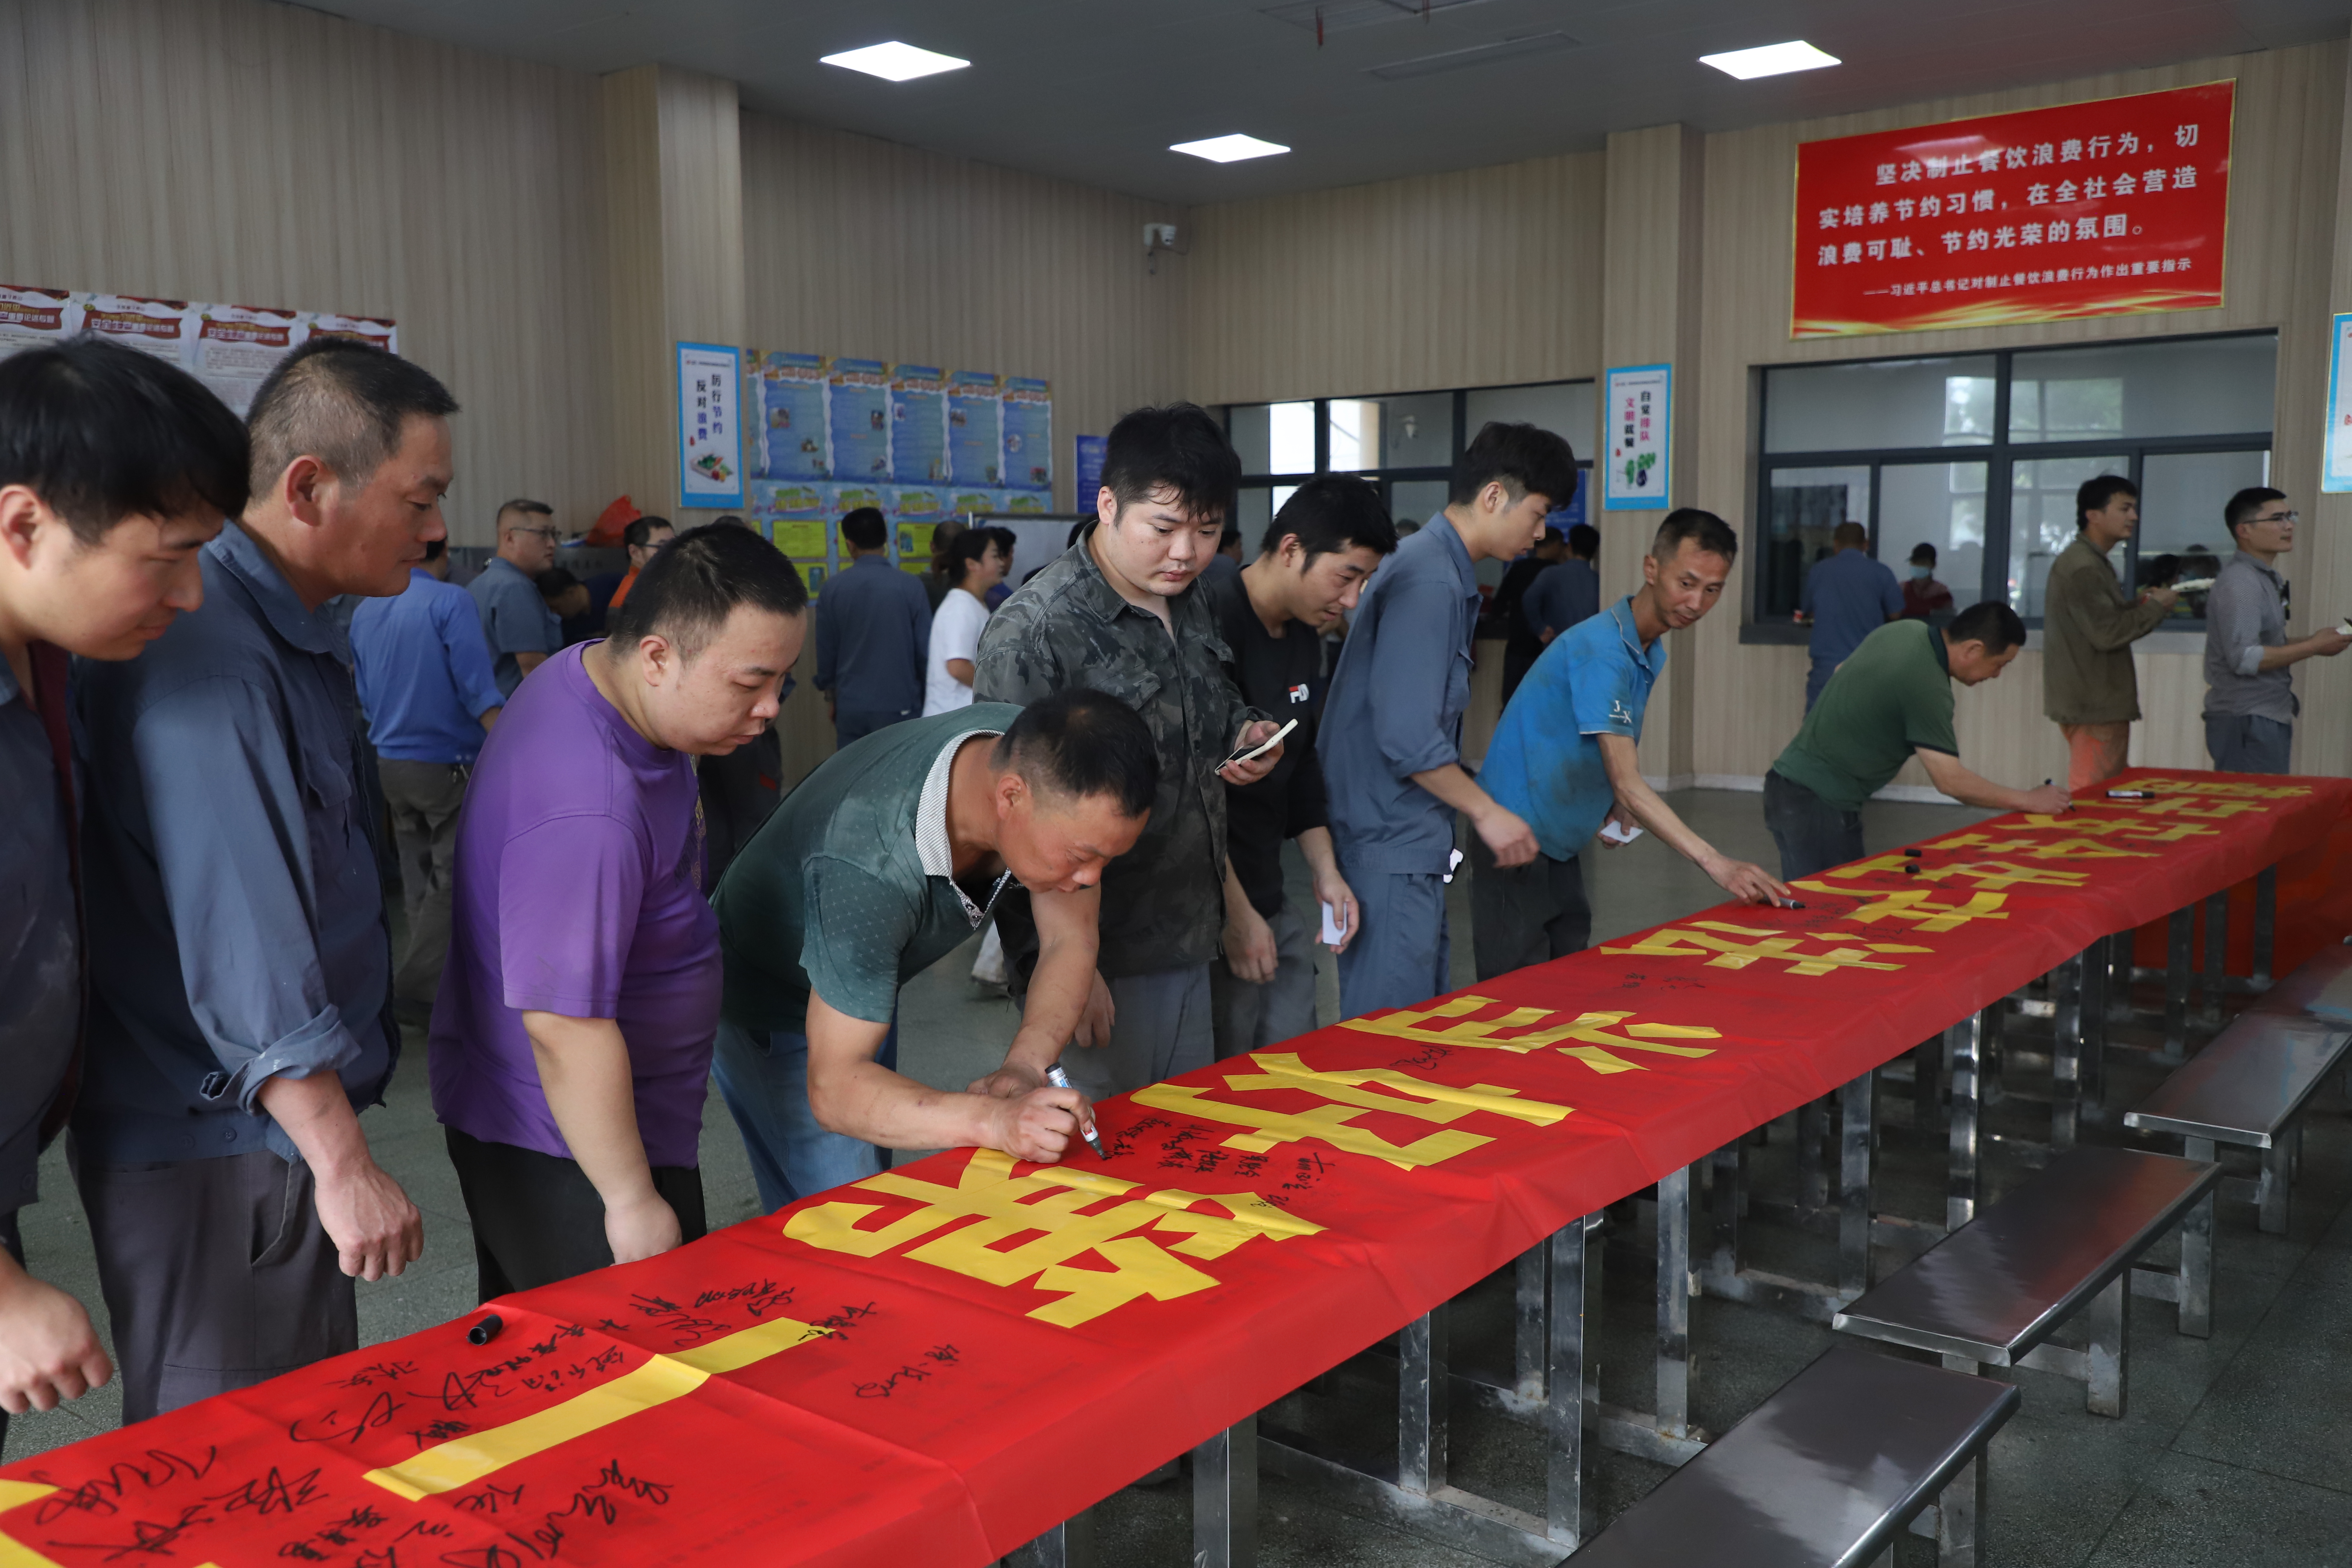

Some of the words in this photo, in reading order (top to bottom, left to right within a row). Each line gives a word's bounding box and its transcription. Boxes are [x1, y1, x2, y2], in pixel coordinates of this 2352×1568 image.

[1876, 124, 2199, 185] 坚决制止餐饮浪费行为，切
[1818, 165, 2198, 229] 实培养节约习惯，在全社会营造
[1818, 213, 2143, 266] 浪费可耻、节约光荣的氛围。
[697, 380, 707, 441] 反对浪费
[711, 374, 723, 435] 厉行节约
